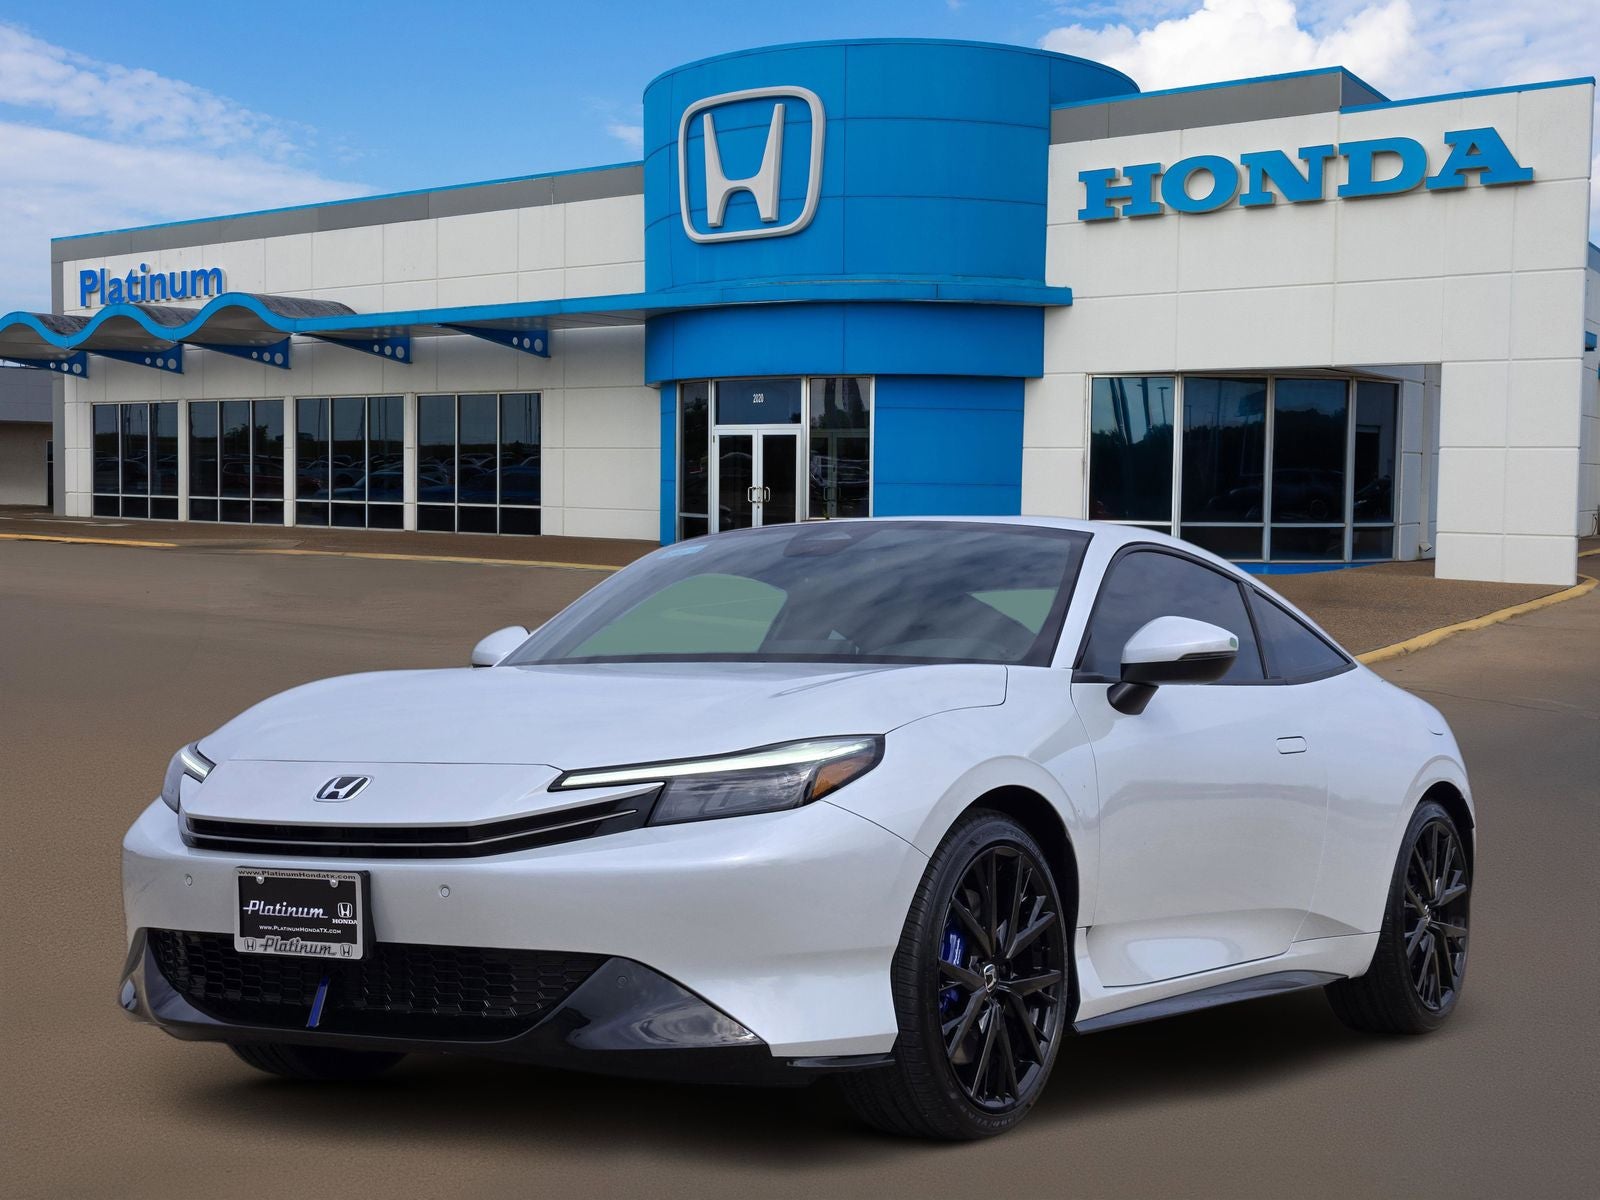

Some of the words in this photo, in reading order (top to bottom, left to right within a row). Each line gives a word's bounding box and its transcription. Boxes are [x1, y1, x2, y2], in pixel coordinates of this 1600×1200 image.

[1078, 126, 1534, 221] HONDA
[80, 263, 225, 307] Platinum
[243, 900, 328, 918] Platinum
[260, 935, 337, 955] Platinum
